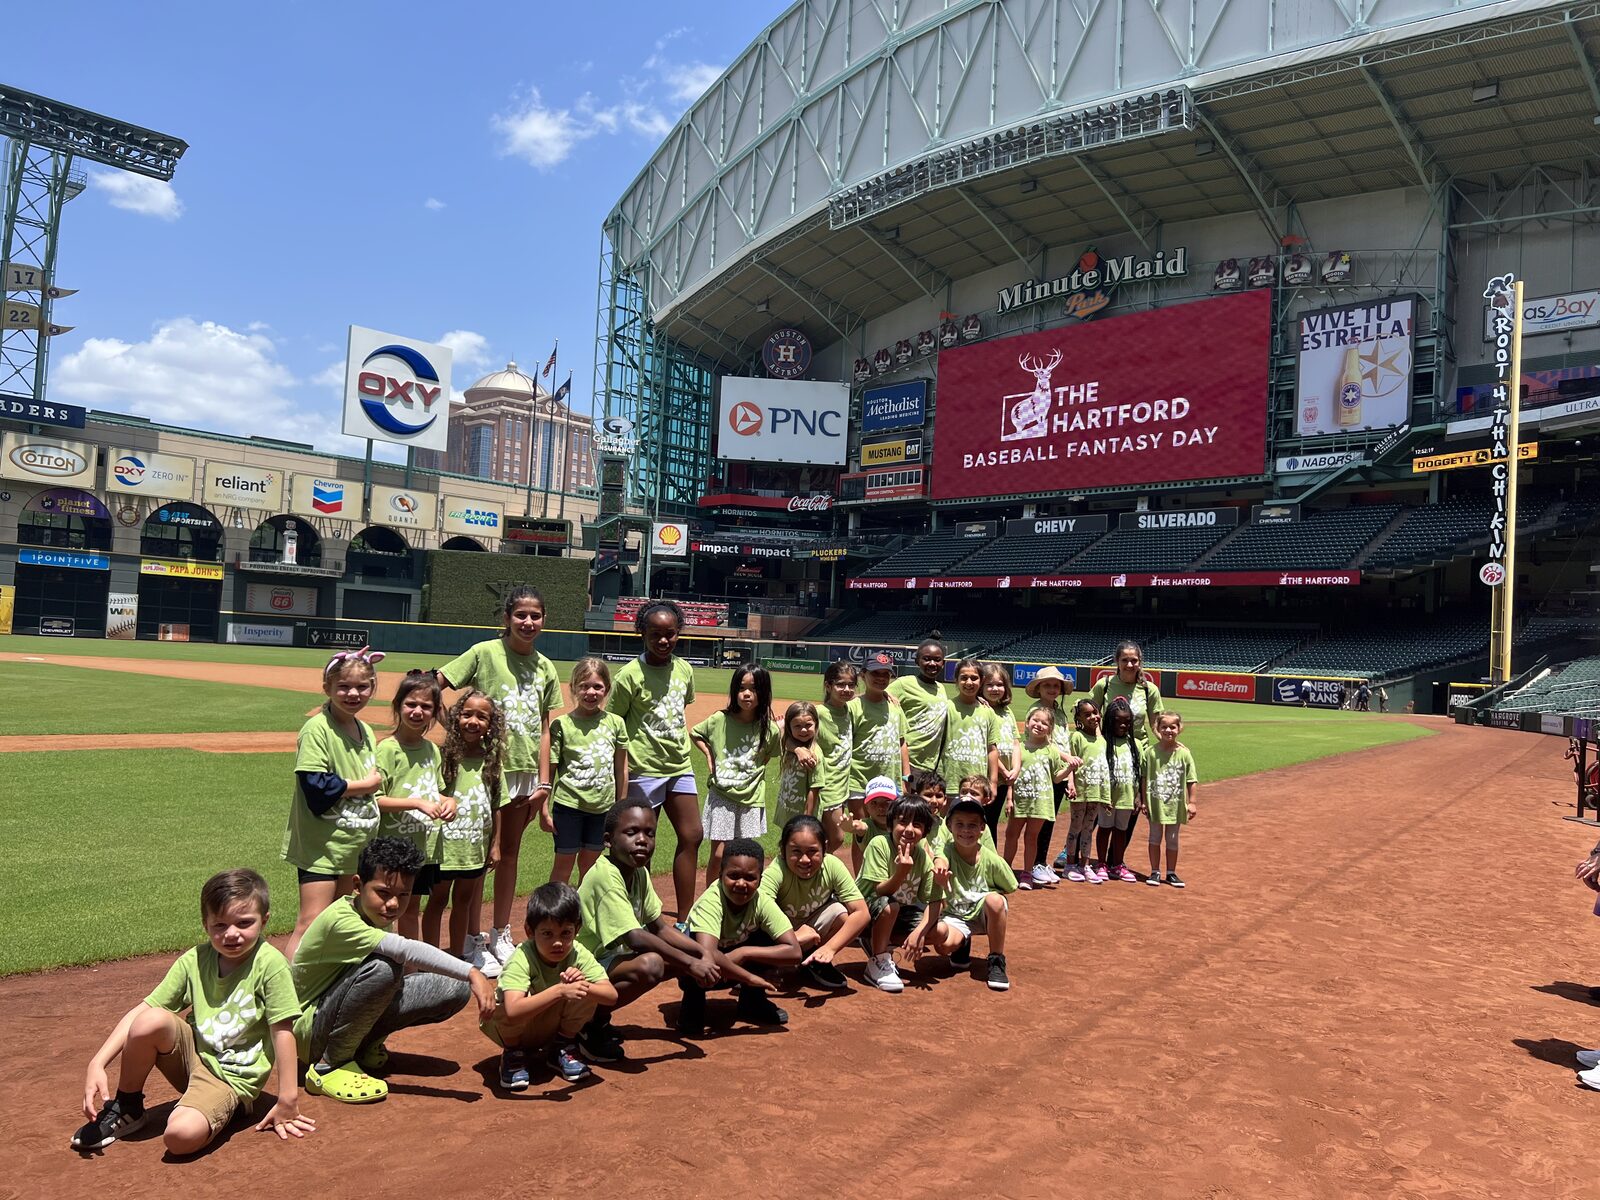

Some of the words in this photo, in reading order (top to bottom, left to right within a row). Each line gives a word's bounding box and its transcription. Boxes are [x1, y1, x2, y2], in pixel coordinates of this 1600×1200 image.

[1291, 254, 1302, 272] 5
[1328, 251, 1342, 270] 7
[14, 271, 34, 285] 17
[997, 270, 1098, 313] Minute
[1105, 247, 1186, 284] Maid
[1064, 291, 1110, 319] Park
[1556, 298, 1596, 317] Bay
[10, 310, 30, 322] 22
[1362, 303, 1392, 324] TU
[1563, 319, 1587, 328] UNION
[770, 331, 806, 345] HOUSTON
[778, 345, 796, 362] H
[1495, 317, 1512, 378] ROOT
[874, 348, 888, 364] 40
[770, 364, 803, 376] ASTROS
[358, 372, 441, 408] OXY
[1054, 382, 1099, 407] THE
[1493, 386, 1507, 401] 4
[866, 396, 920, 416] Methodist
[1565, 399, 1600, 413] ULTRA
[768, 407, 842, 437] PNC
[1052, 398, 1190, 434] HARTFORD
[593, 434, 640, 446] Gallagher
[596, 444, 636, 454] INSURANCE
[868, 446, 902, 459] MUSTANG
[906, 444, 920, 456] CAT
[963, 444, 1058, 469] BASEBALL
[1067, 433, 1163, 458] FANTASY
[1172, 426, 1219, 448] DAY
[20, 450, 76, 473] COTTON
[1302, 454, 1353, 468] NABORS
[1418, 455, 1472, 469] DOGGETT
[114, 466, 146, 476] OXY
[152, 470, 174, 481] ZERO
[215, 476, 266, 493] reliant
[314, 479, 344, 490] Chevron
[57, 498, 90, 508] planet
[60, 504, 96, 516] fitness
[722, 508, 758, 517] HORNITOS
[388, 514, 418, 525] QUANTA
[465, 508, 498, 528] LNG
[1138, 512, 1216, 528] SILVERADO
[1034, 519, 1076, 534] CHEVY
[760, 529, 800, 538] HORNITOS
[699, 542, 739, 554] impact
[751, 546, 791, 558] impact
[811, 548, 848, 557] PLUCKERS
[32, 554, 100, 566] 1POINTFIVE
[170, 566, 190, 574] PAPA
[190, 566, 220, 577] JOHN'S
[1288, 576, 1303, 584] THE
[1305, 576, 1350, 585] HARTFORD
[274, 596, 290, 606] 66
[110, 607, 136, 616] WM
[244, 626, 284, 638] Insperity
[322, 632, 363, 642] VERITEX
[1490, 712, 1520, 721] HARGROVE
